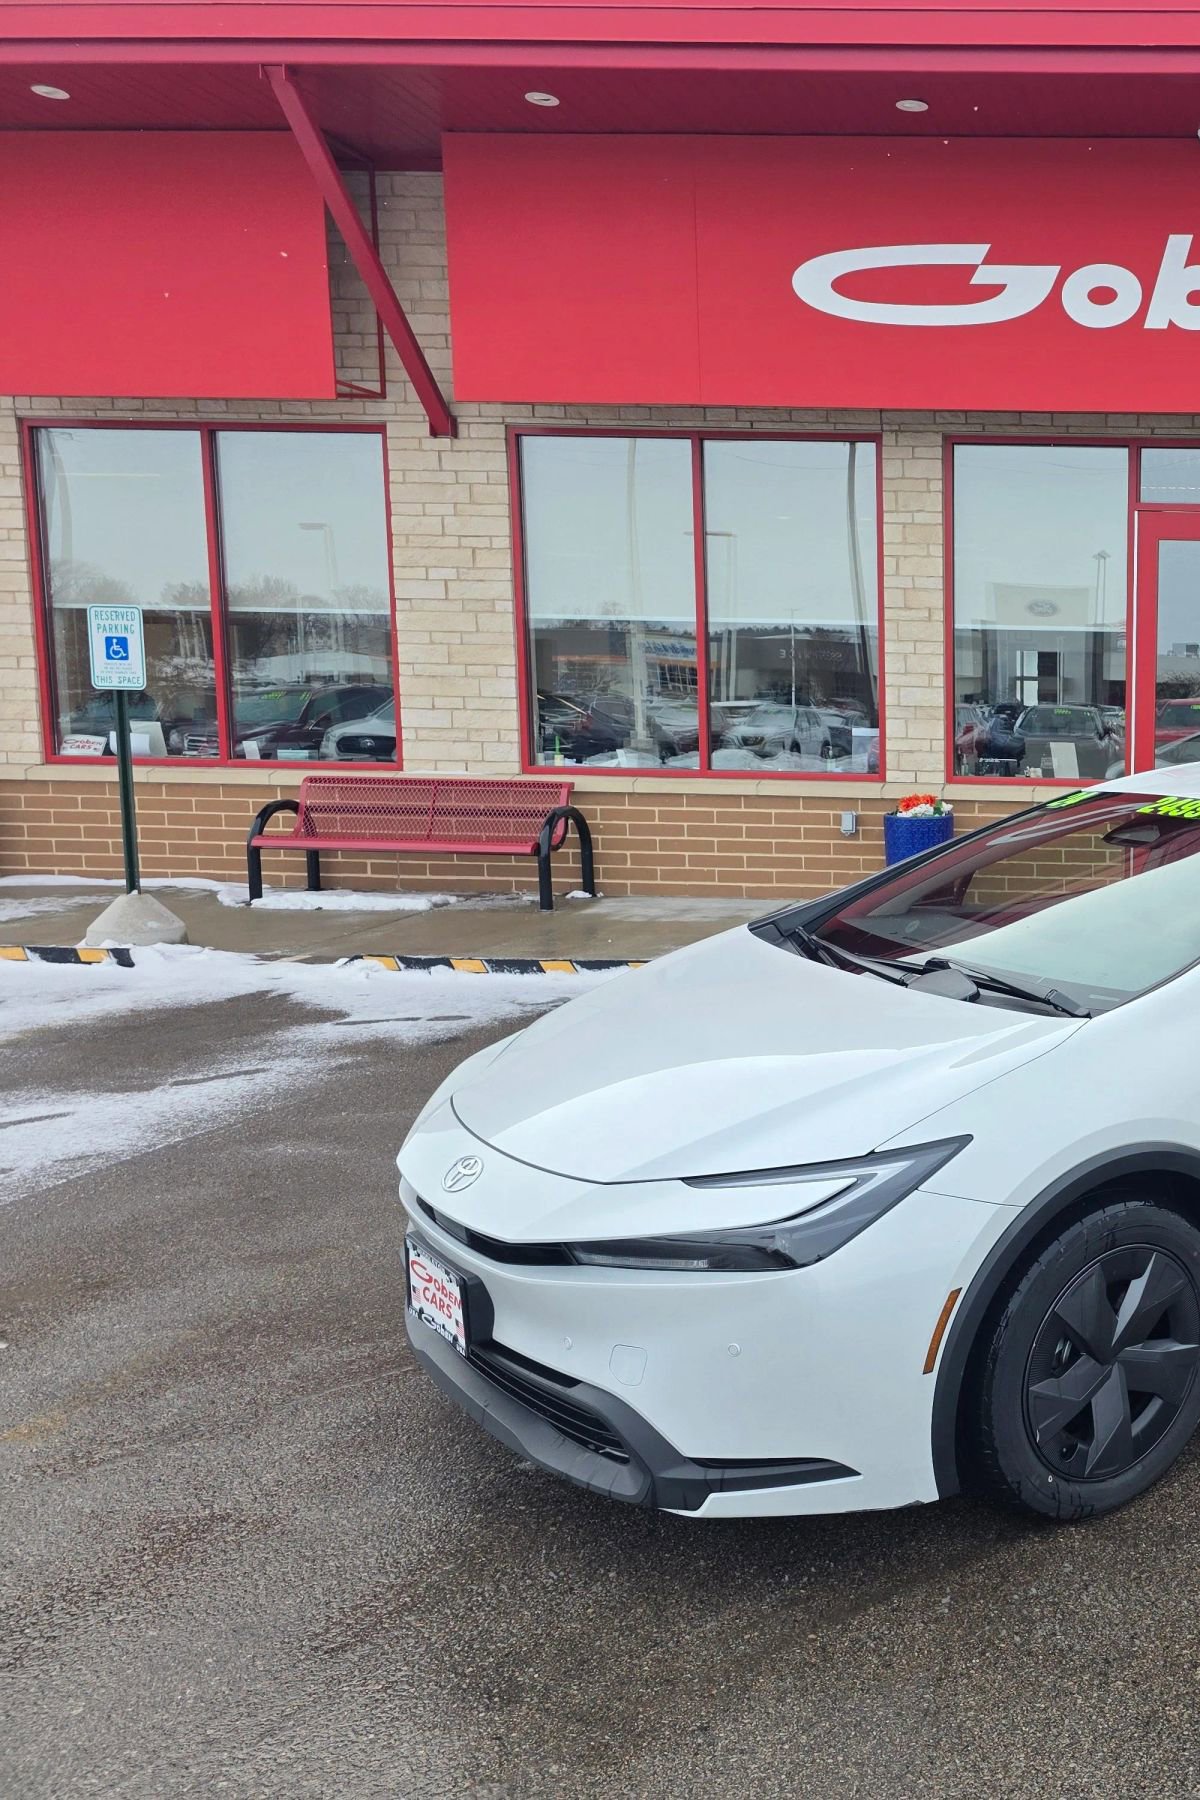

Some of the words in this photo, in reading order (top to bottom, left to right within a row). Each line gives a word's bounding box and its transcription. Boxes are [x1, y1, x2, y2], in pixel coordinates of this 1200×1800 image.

[95, 610, 136, 621] RESERVED
[97, 624, 135, 634] PARKING
[96, 675, 112, 684] THIS
[118, 676, 142, 685] SPACE
[422, 1286, 453, 1319] CARS
